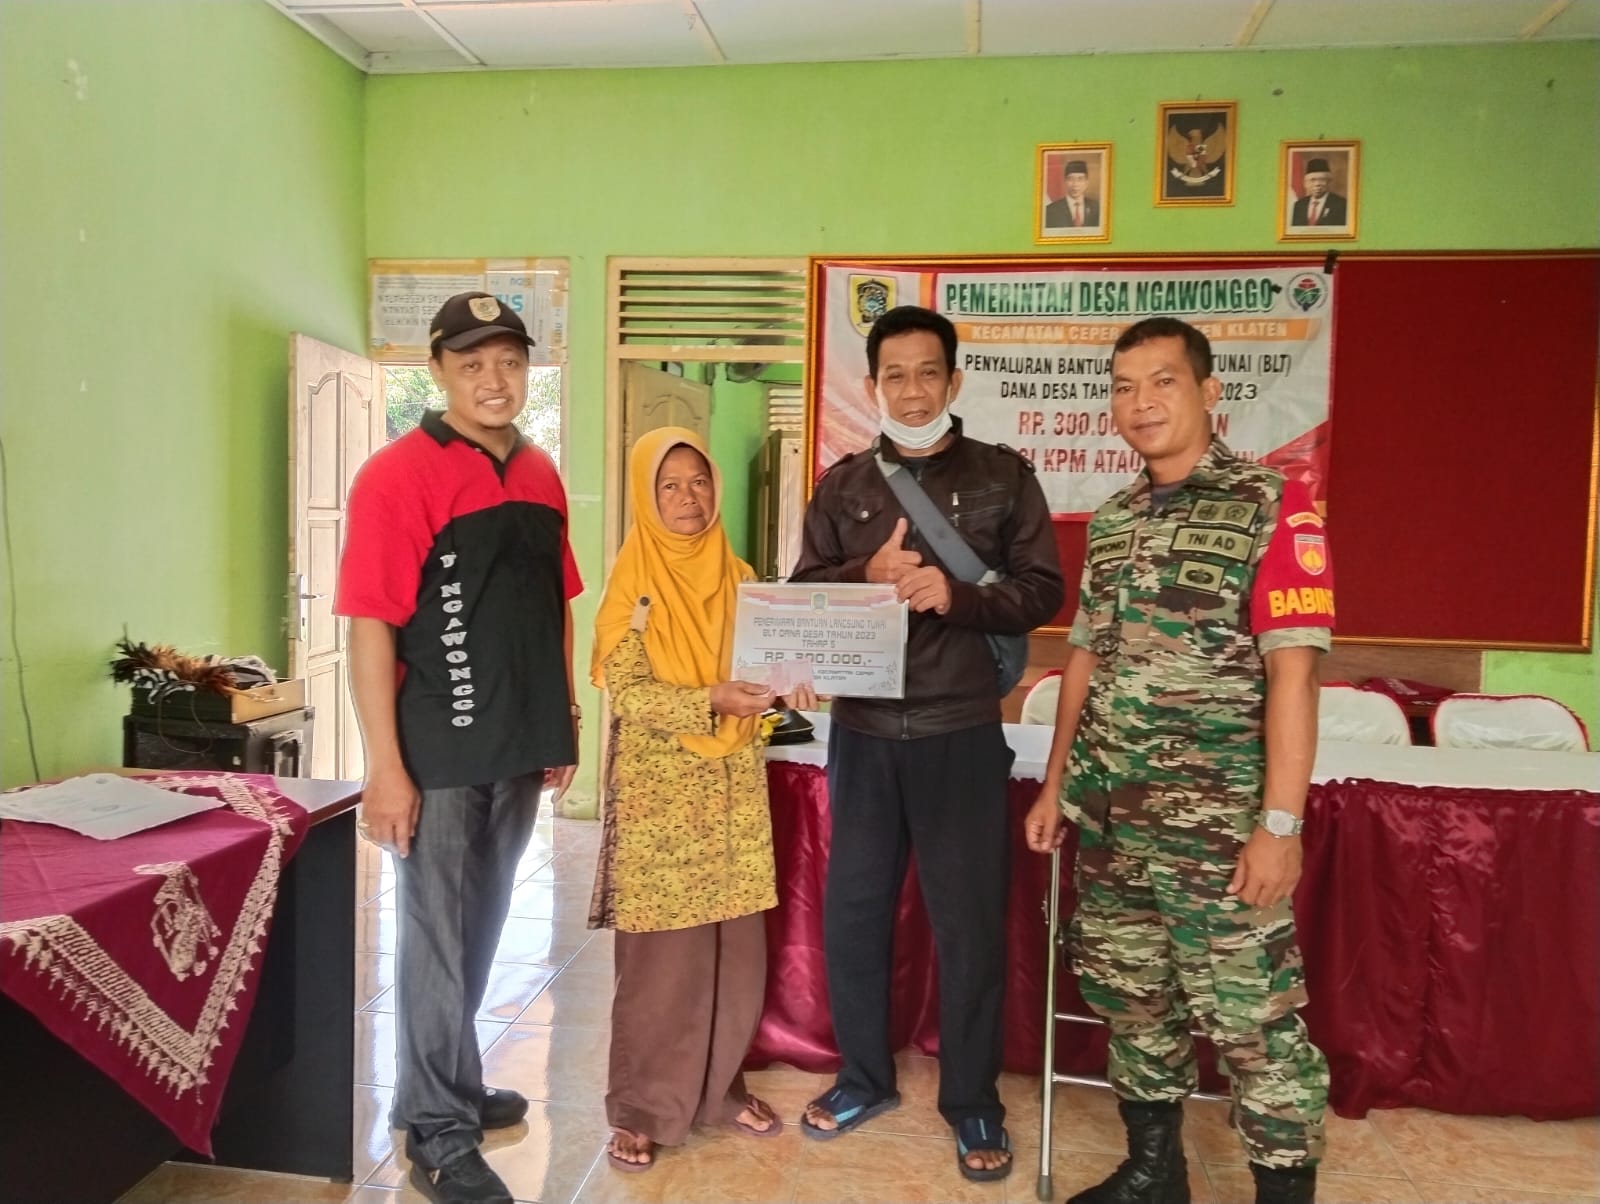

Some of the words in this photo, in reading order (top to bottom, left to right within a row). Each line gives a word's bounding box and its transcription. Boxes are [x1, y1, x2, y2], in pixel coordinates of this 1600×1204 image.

[946, 282, 1072, 313] PEMERINTAH
[1079, 281, 1129, 313] DESA
[1136, 278, 1273, 312] NGAWONGGO
[973, 325, 1064, 341] KECAMATAN
[1069, 326, 1120, 341] CEPER
[1227, 322, 1287, 337] KLATEN
[965, 354, 1052, 374] PENYALURAN
[1058, 358, 1112, 375] BANTUA
[1211, 354, 1251, 372] TUNAI
[1258, 354, 1292, 377] (BLT)
[1001, 381, 1037, 399] DANA
[1042, 382, 1077, 399] DESA
[1018, 411, 1045, 435] RP.
[1044, 448, 1085, 473] KPM
[1093, 449, 1142, 473] ATAU
[1188, 532, 1208, 546] TNI
[1212, 536, 1236, 551] AD
[803, 630, 824, 638] DESA
[827, 630, 853, 639] TAHUN
[855, 631, 876, 640] 2023
[440, 582, 476, 727] NGAWONGGO
